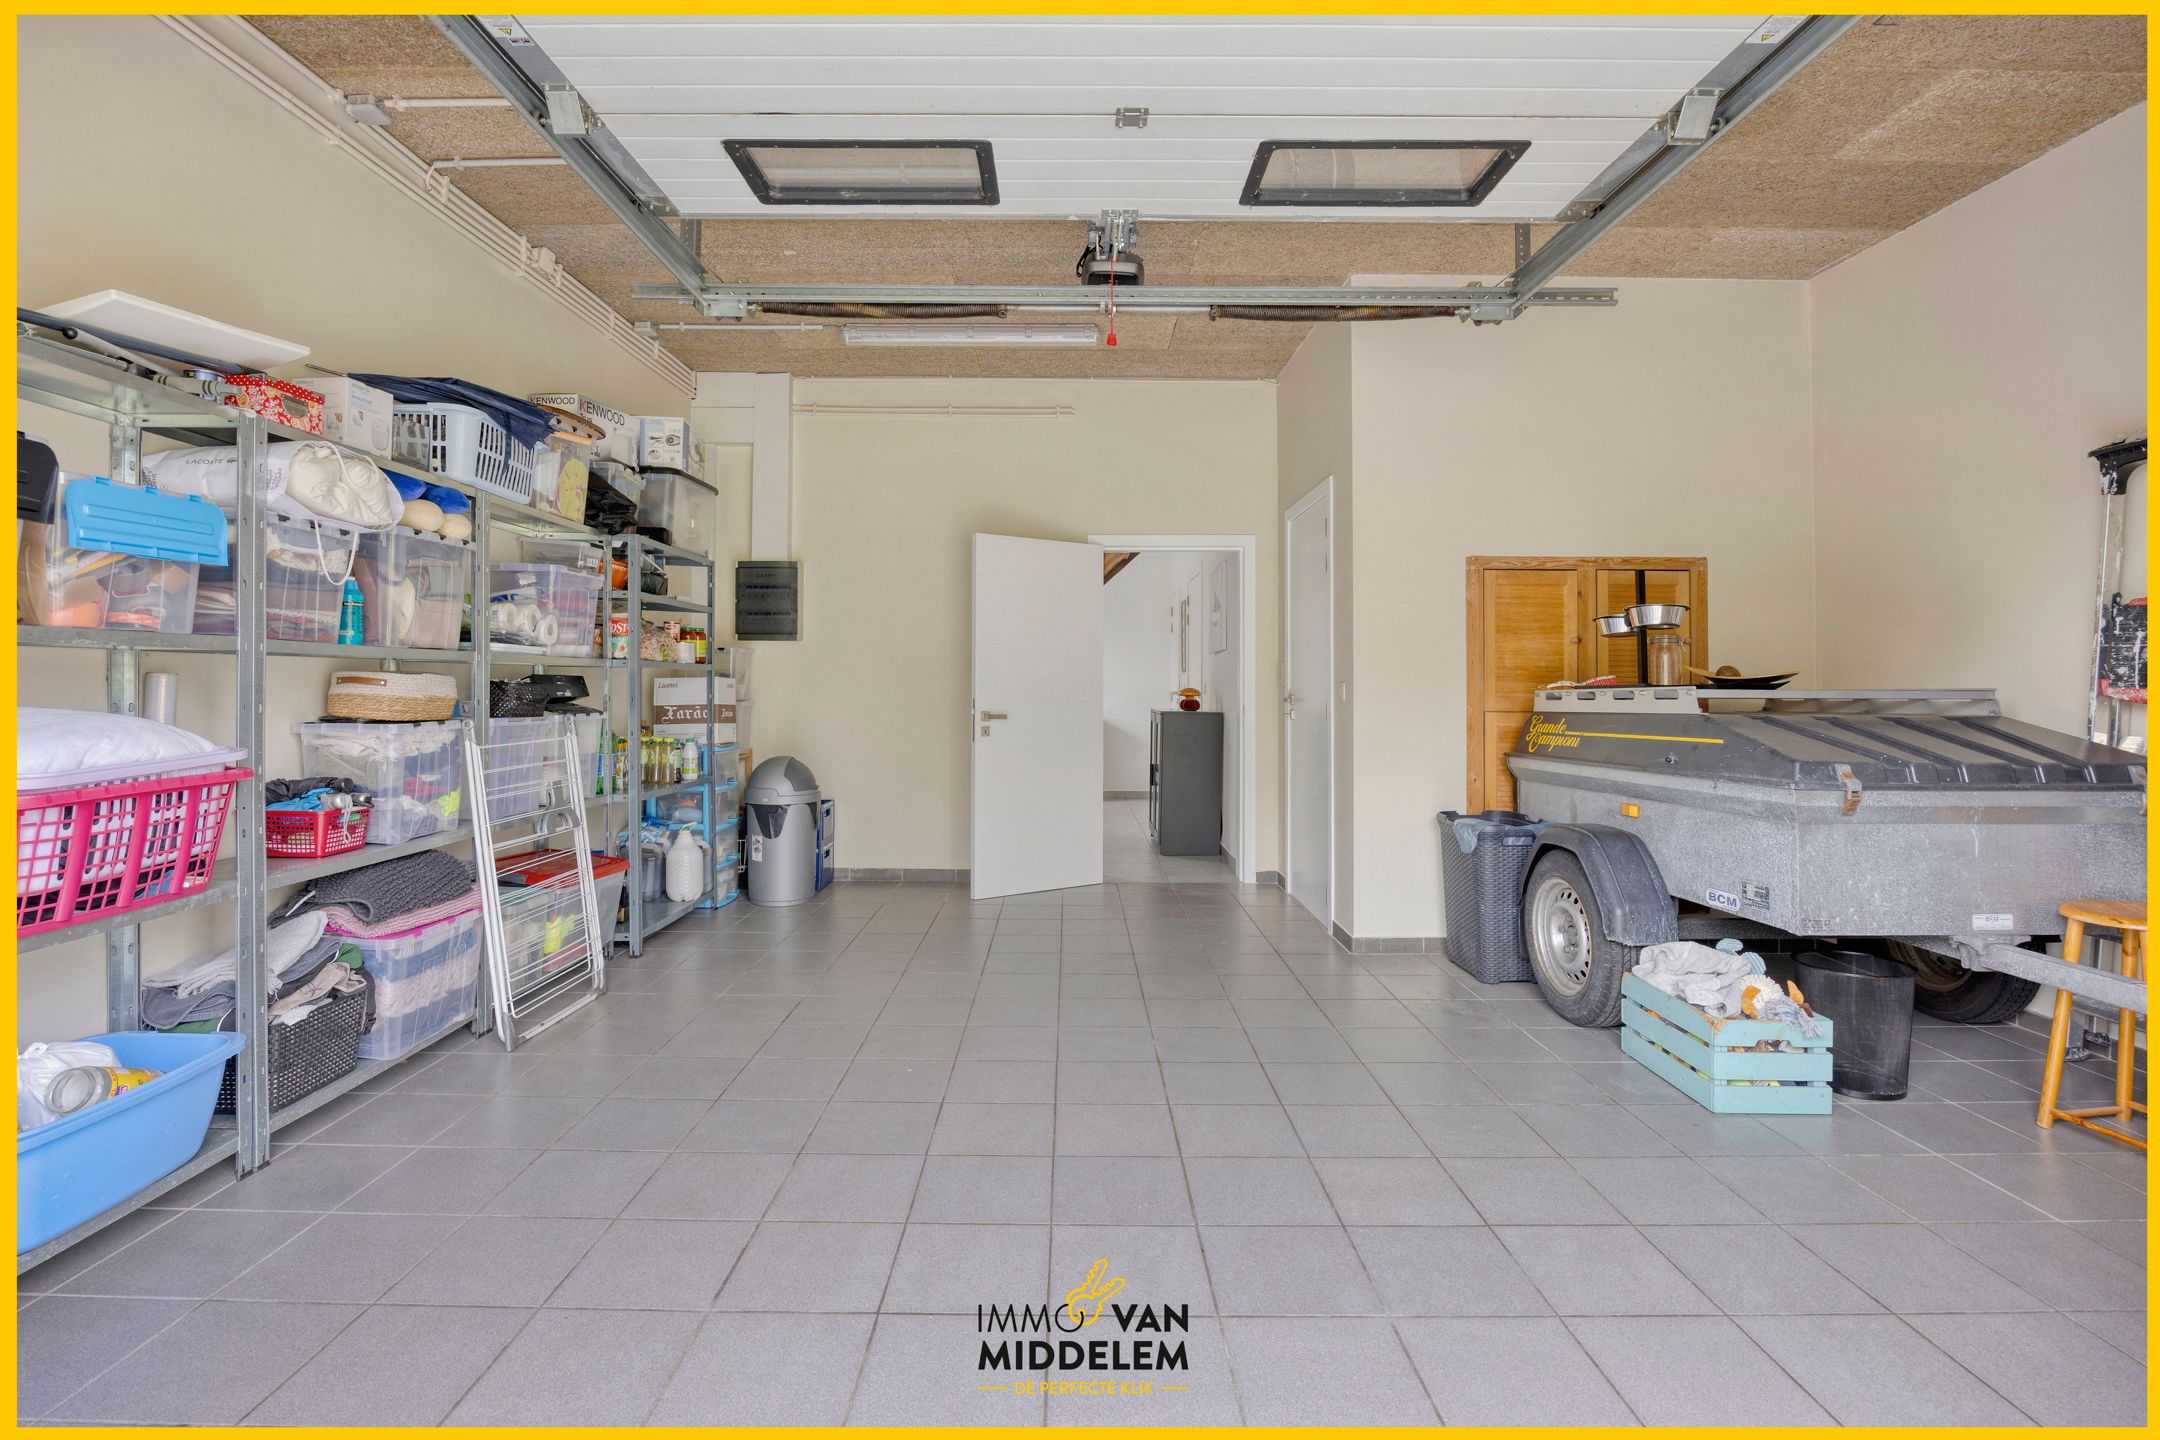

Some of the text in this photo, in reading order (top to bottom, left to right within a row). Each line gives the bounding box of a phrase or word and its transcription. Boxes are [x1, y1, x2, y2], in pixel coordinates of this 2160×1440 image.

[530, 396, 576, 405] KENWOOD
[580, 398, 625, 426] KENWOOD
[1526, 715, 1567, 741] Grande
[1528, 732, 1581, 752] Campioni
[1708, 891, 1738, 908] BCM
